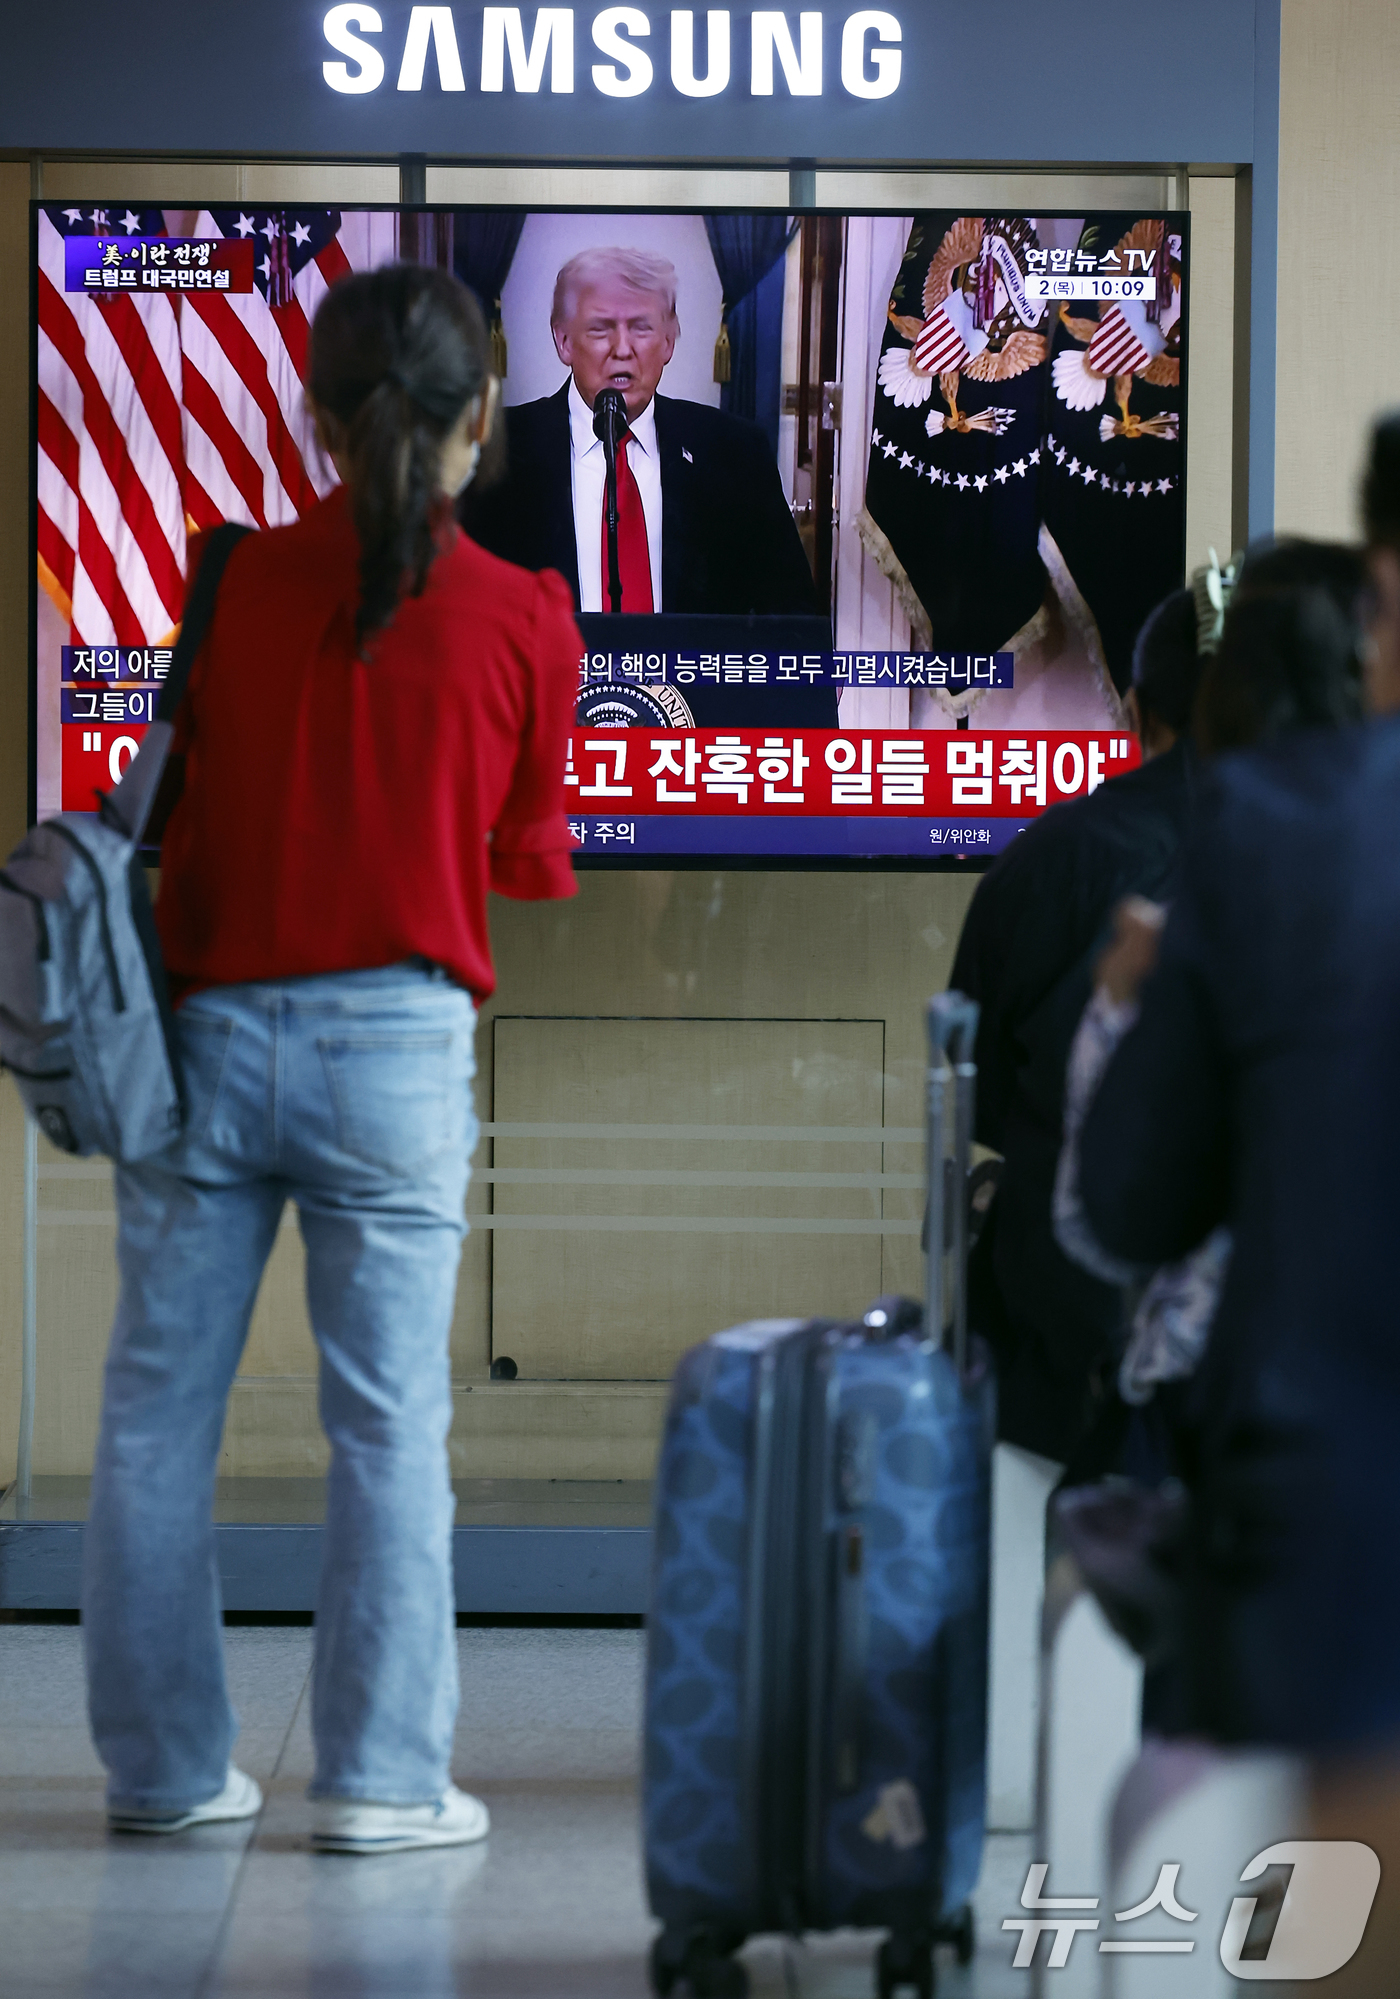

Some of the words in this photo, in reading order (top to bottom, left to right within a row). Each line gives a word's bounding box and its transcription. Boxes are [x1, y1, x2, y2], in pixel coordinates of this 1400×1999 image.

[322, 3, 902, 99] SAMSUNG
[1025, 248, 1156, 273] 연합뉴스TV
[84, 269, 138, 288] 트럼프
[142, 269, 230, 288] 대국민연설
[1092, 280, 1144, 296] 10:09
[73, 649, 120, 679] 저의
[621, 653, 666, 683] 핵의
[674, 653, 770, 684] 능력들을
[776, 655, 824, 684] 모두
[831, 655, 1002, 685] 괴멸시켰습니다.
[72, 692, 153, 722] 그들이
[647, 736, 810, 804] 잔혹한
[824, 738, 930, 805] 일들
[946, 738, 1128, 806] 멈춰야"
[594, 822, 635, 844] 주의
[929, 828, 992, 844] 원/위안화
